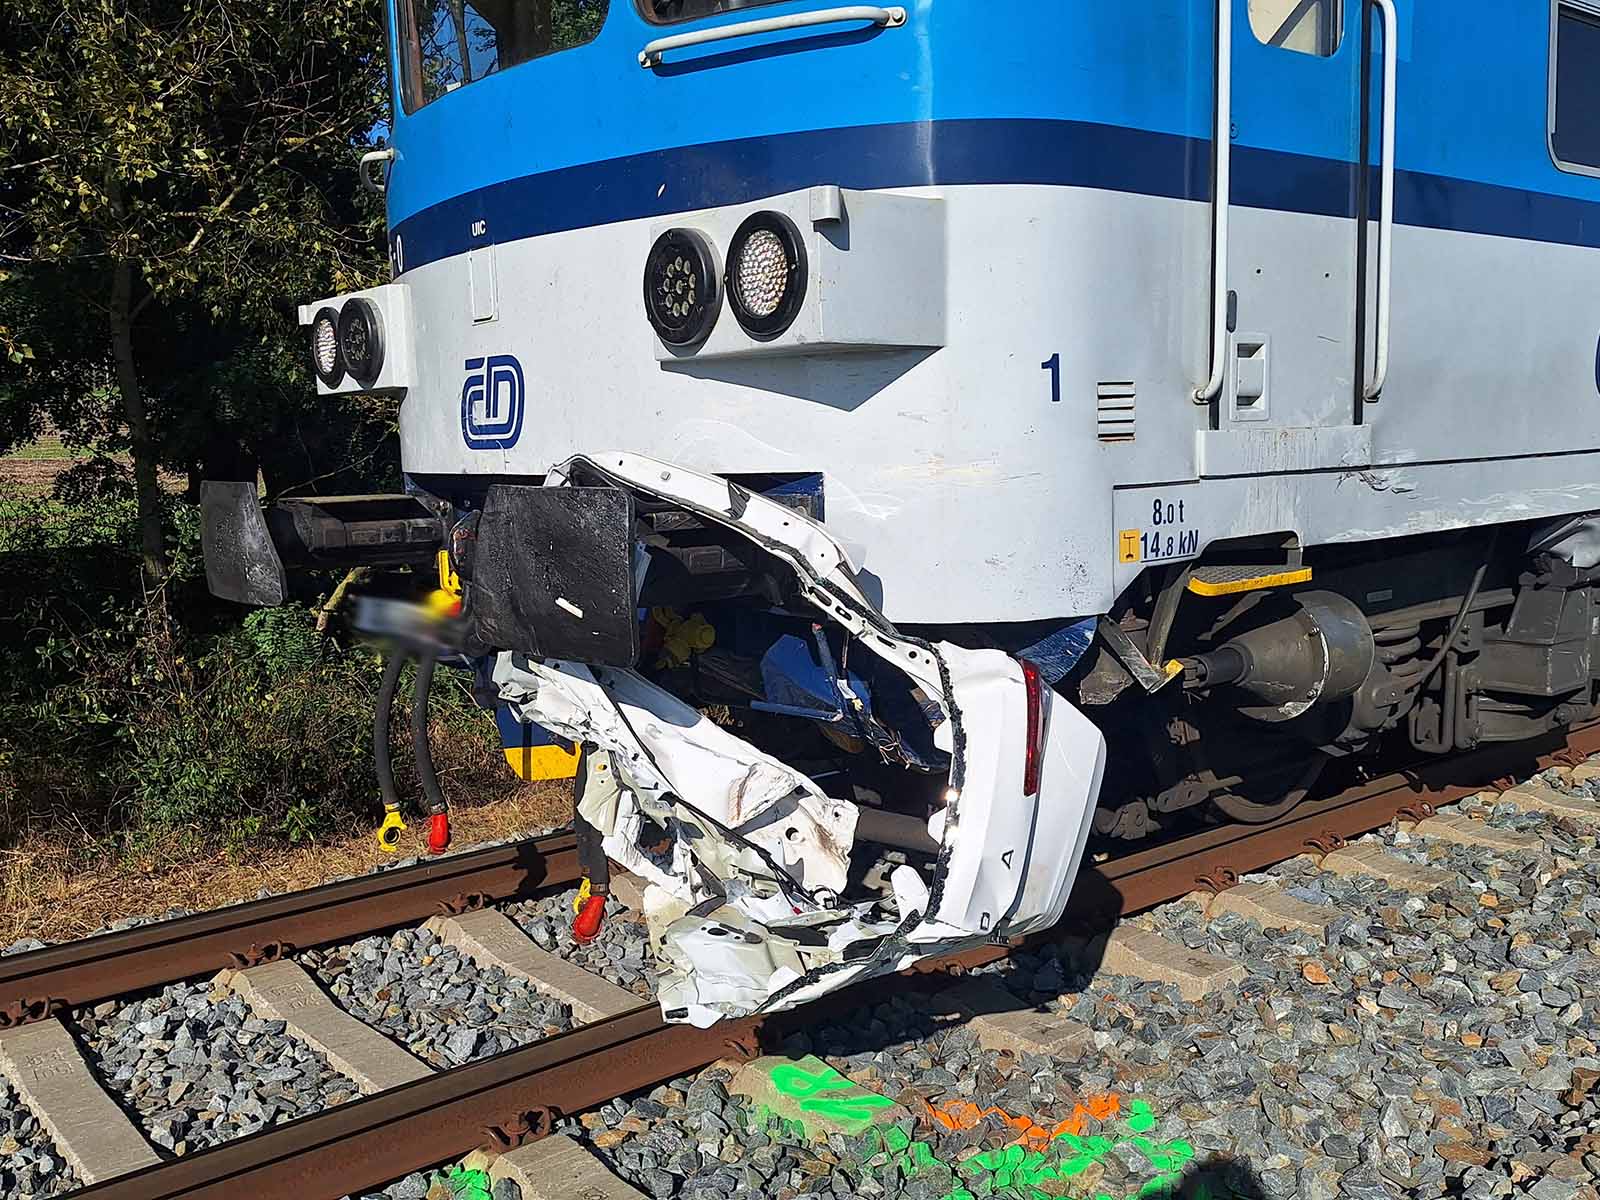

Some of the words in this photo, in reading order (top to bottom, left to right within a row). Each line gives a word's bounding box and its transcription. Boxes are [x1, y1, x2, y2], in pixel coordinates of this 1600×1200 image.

[471, 219, 487, 237] UIC
[1041, 353, 1061, 402] 1
[1152, 498, 1175, 526] 8.0
[1178, 499, 1185, 523] t
[1140, 531, 1174, 560] 14.8
[1178, 529, 1199, 555] kN
